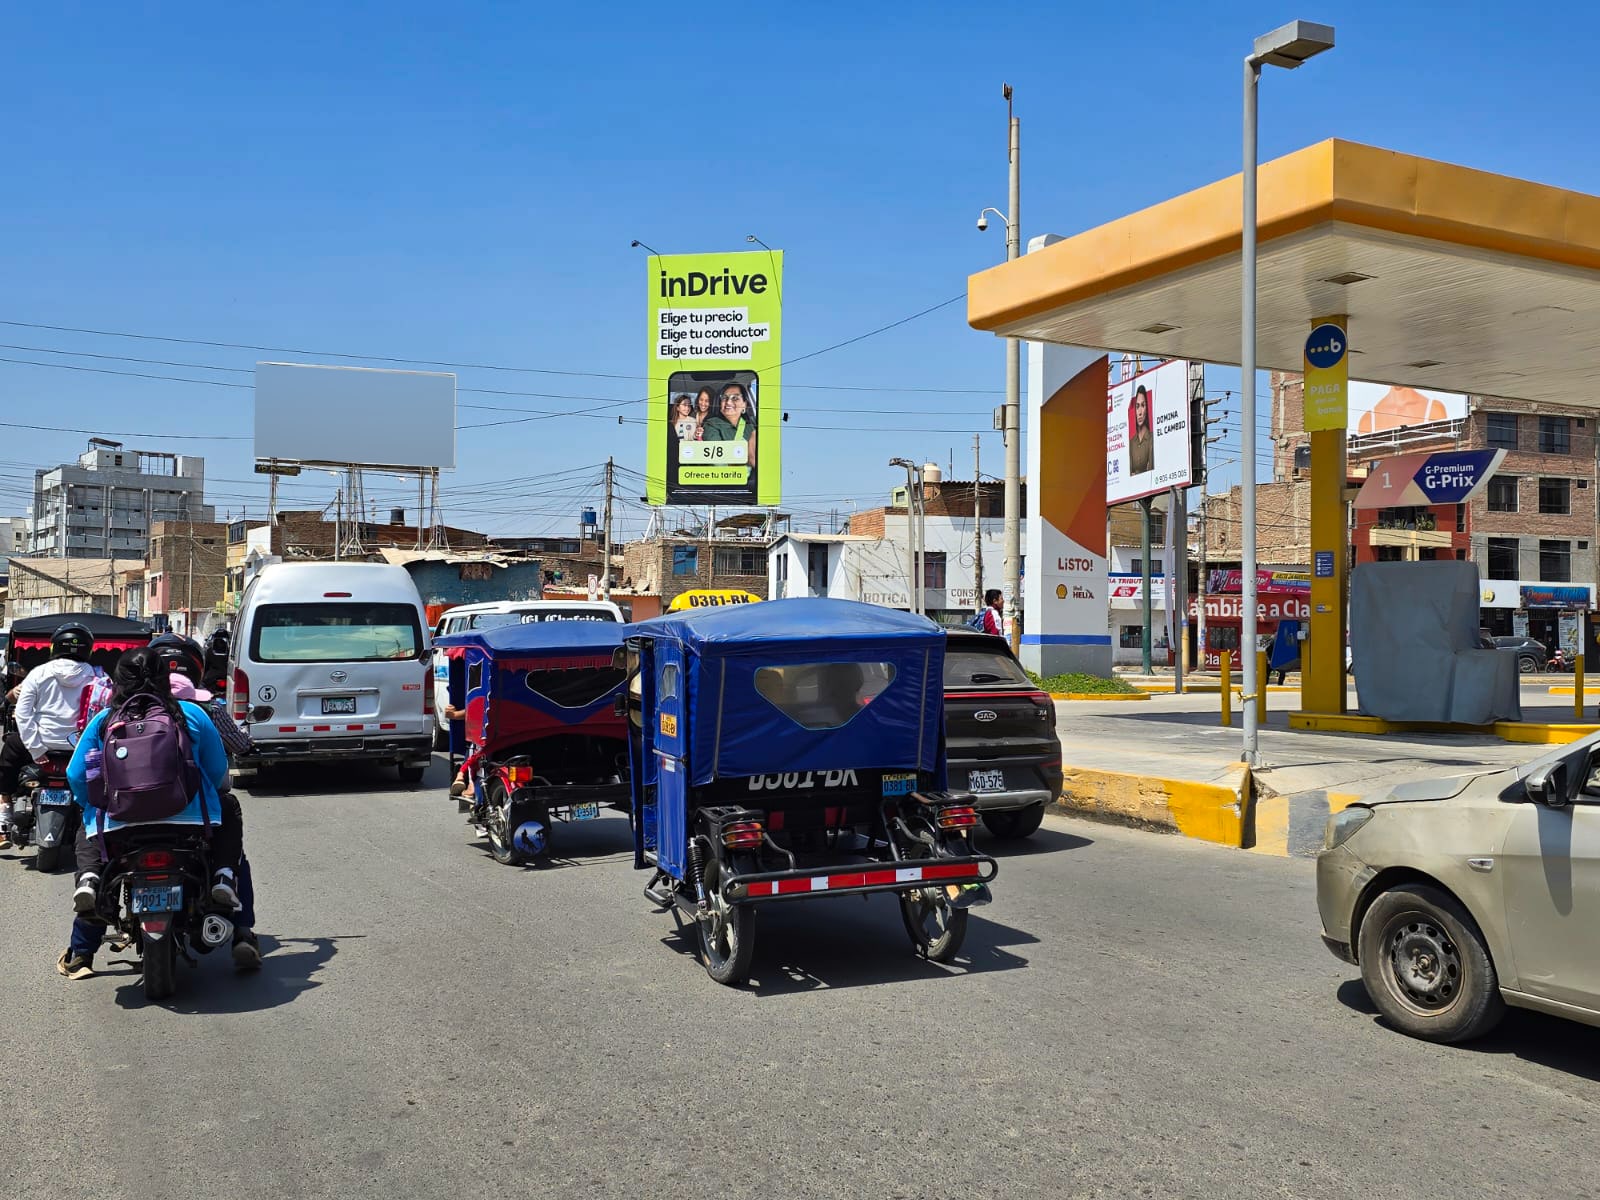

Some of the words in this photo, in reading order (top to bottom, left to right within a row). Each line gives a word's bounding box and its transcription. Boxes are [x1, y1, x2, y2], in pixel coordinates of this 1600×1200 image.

[661, 268, 768, 297] inDrive
[661, 313, 687, 326] Elige
[690, 313, 703, 323] tu
[705, 311, 743, 325] precio
[661, 329, 687, 342] Elige
[690, 329, 703, 339] tu
[705, 327, 767, 339] conductor
[661, 345, 687, 358] Elige
[690, 345, 703, 355] tu
[705, 343, 749, 354] destino
[1310, 384, 1341, 395] PAGA
[1156, 410, 1179, 424] DOMINA
[1156, 427, 1163, 436] EL
[1164, 421, 1186, 434] CAMBIO
[703, 446, 724, 459] S/8
[684, 471, 710, 479] Ofrece
[711, 471, 719, 479] tu
[720, 471, 742, 479] tarifa
[1425, 464, 1474, 474] G-Premium
[1382, 472, 1393, 488] 1
[1426, 473, 1474, 489] G-Prix
[863, 593, 907, 604] BOTICA
[951, 589, 979, 598] CONS
[1270, 604, 1279, 617] a
[264, 688, 272, 700] 5
